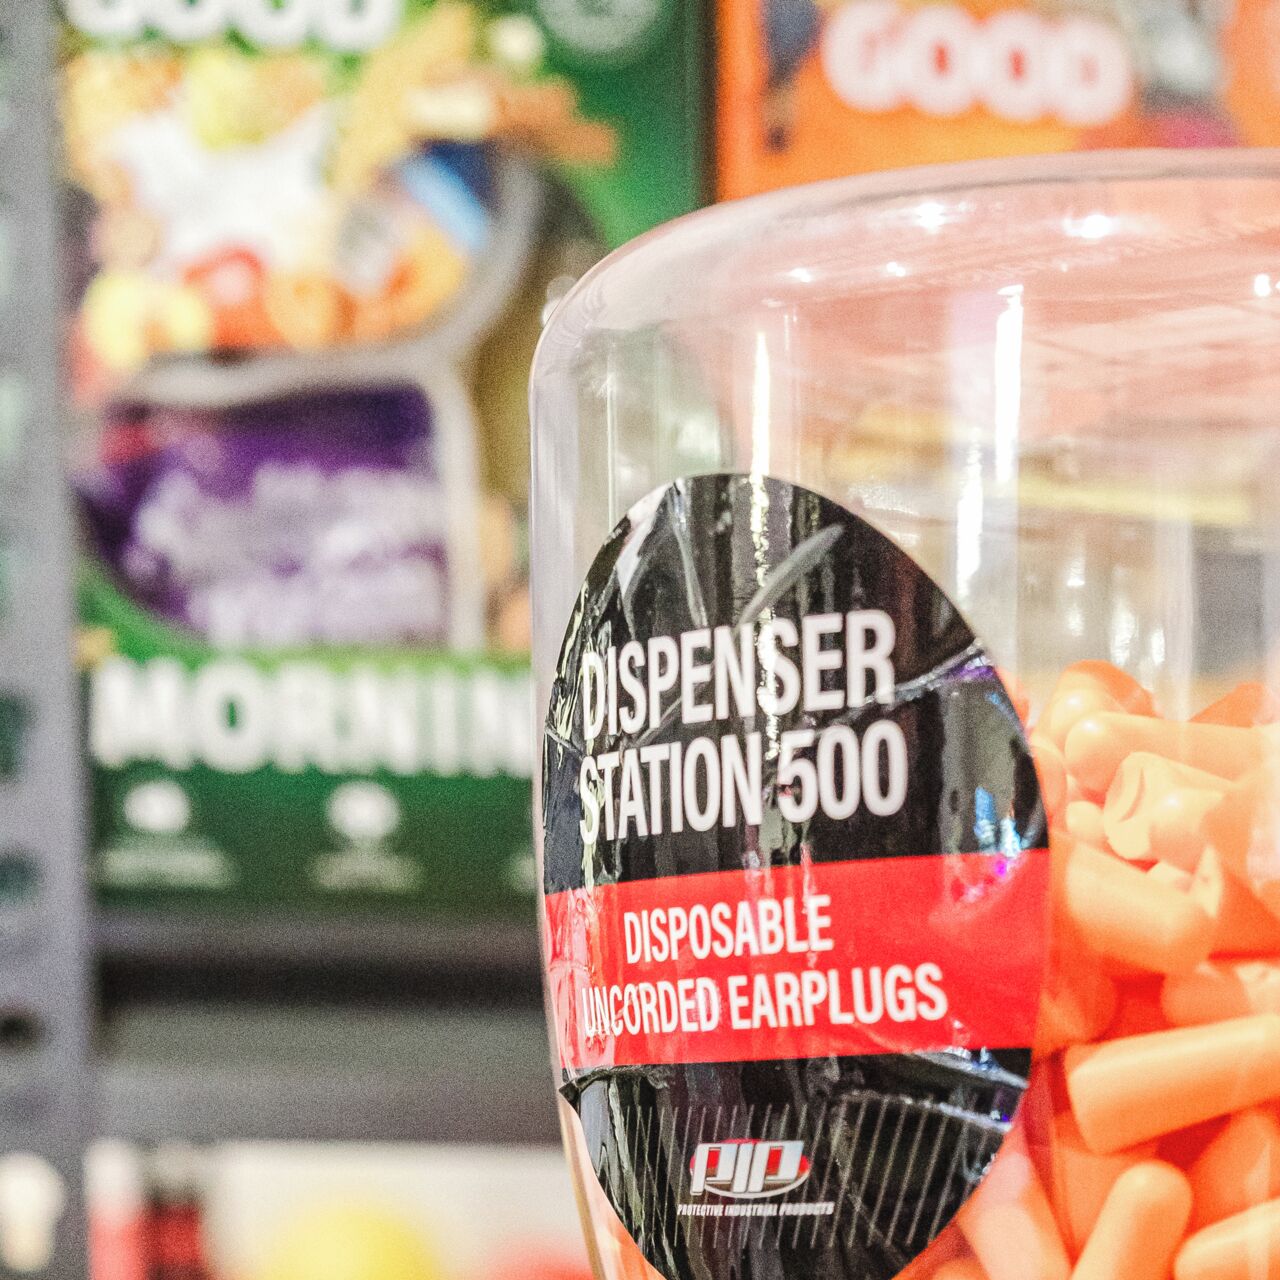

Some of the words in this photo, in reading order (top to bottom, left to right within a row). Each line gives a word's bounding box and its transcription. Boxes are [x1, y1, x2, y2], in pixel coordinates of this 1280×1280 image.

[821, 0, 1131, 127] GOOD
[581, 609, 896, 741] DISPENSER
[579, 731, 764, 851] STATION
[776, 719, 908, 824] 500
[624, 894, 834, 965] DISPOSABLE
[581, 976, 720, 1039] UNCORDED
[729, 962, 949, 1031] EARPLUGS
[676, 1203, 725, 1217] PROTECTIVE
[725, 1203, 778, 1217] INDUSTRIAL
[778, 1201, 836, 1216] PRODUCTS
